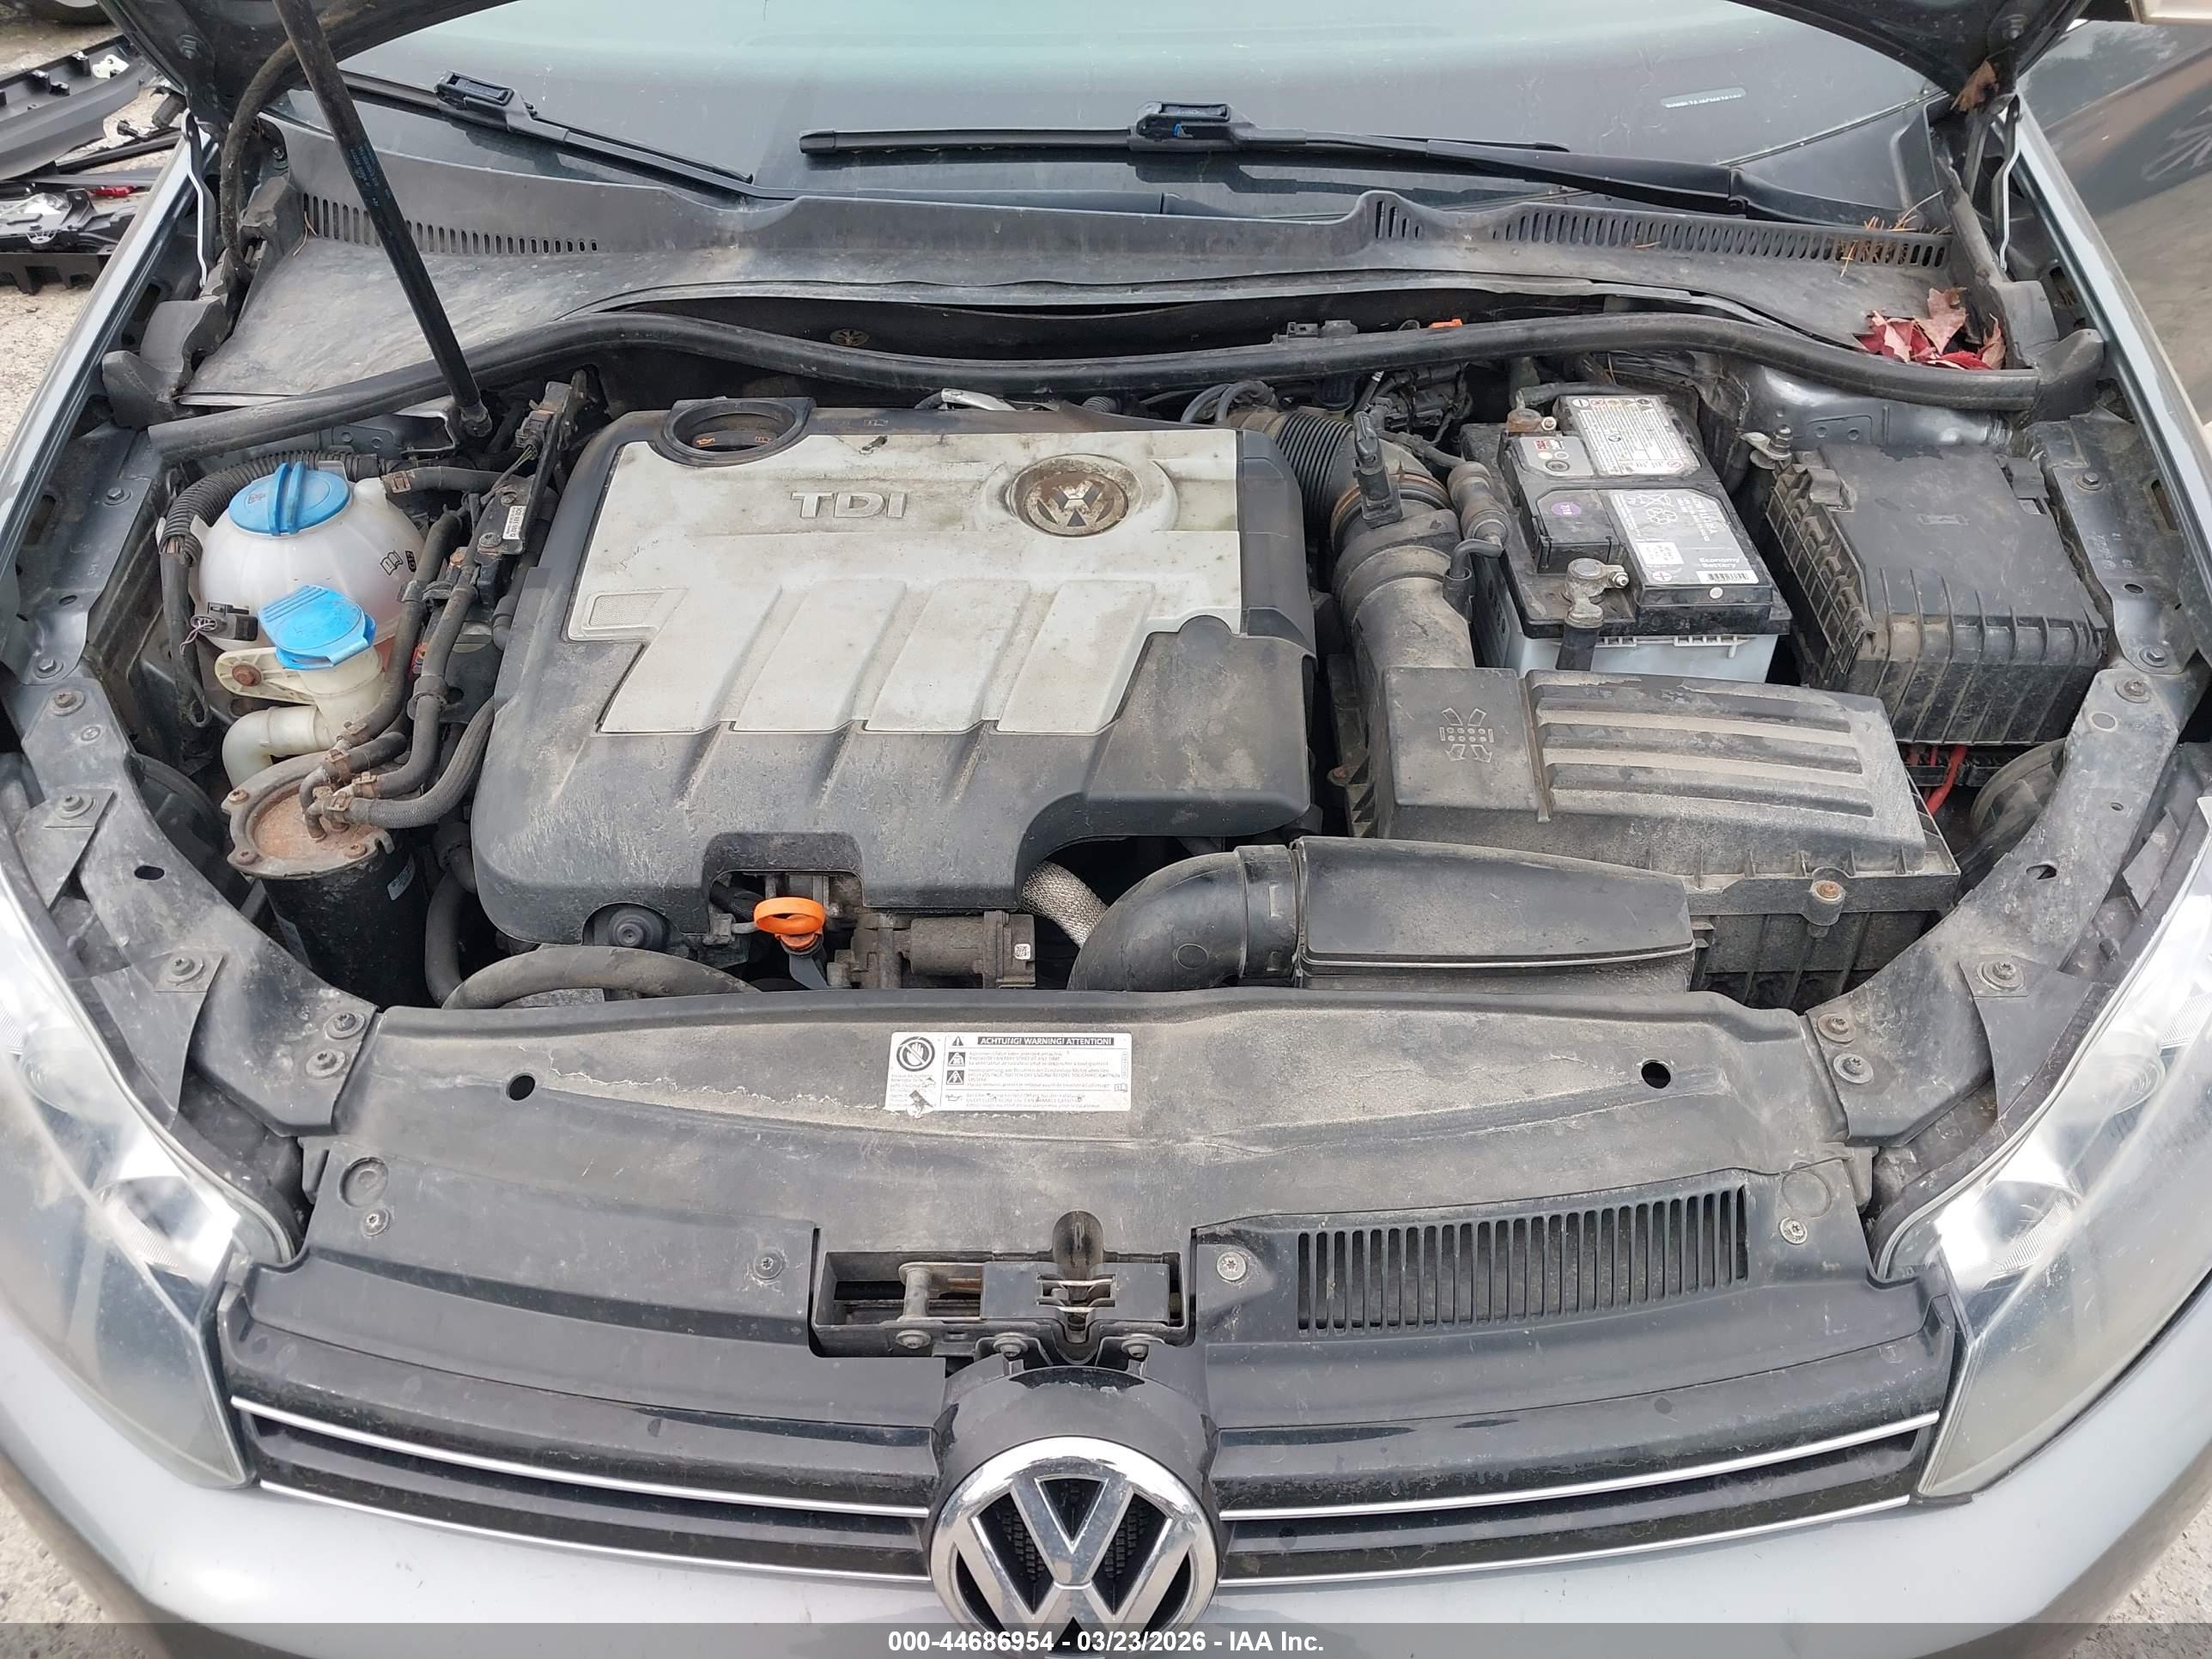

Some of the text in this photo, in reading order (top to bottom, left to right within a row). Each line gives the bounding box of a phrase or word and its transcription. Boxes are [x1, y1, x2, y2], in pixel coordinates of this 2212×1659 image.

[790, 491, 908, 519] TDI
[405, 550, 416, 570] G12
[980, 1036, 1112, 1046] ACHTUNG! WARNING! ATTENTION!
